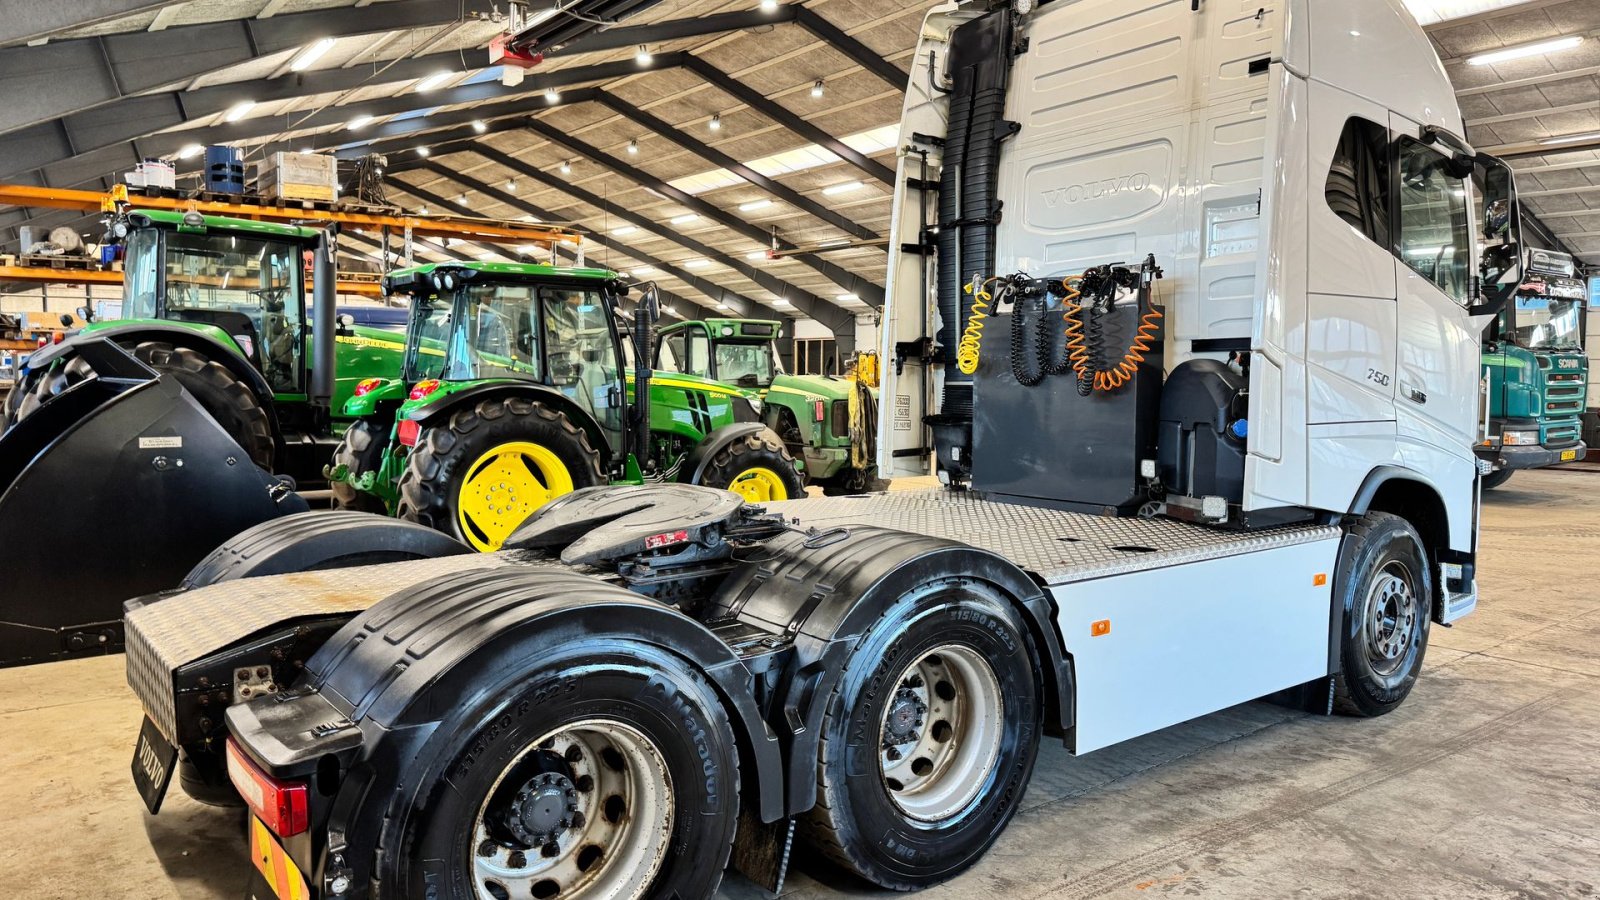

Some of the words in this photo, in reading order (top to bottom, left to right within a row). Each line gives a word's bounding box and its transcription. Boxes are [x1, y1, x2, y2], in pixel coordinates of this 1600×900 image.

[1041, 172, 1151, 208] VOLVO
[1558, 358, 1579, 369] SCANIA
[1367, 368, 1390, 387] 750
[987, 619, 997, 631] R
[854, 637, 904, 741] Matador
[516, 699, 530, 718] R
[139, 734, 164, 790] VOLVO
[672, 694, 720, 807] Matador
